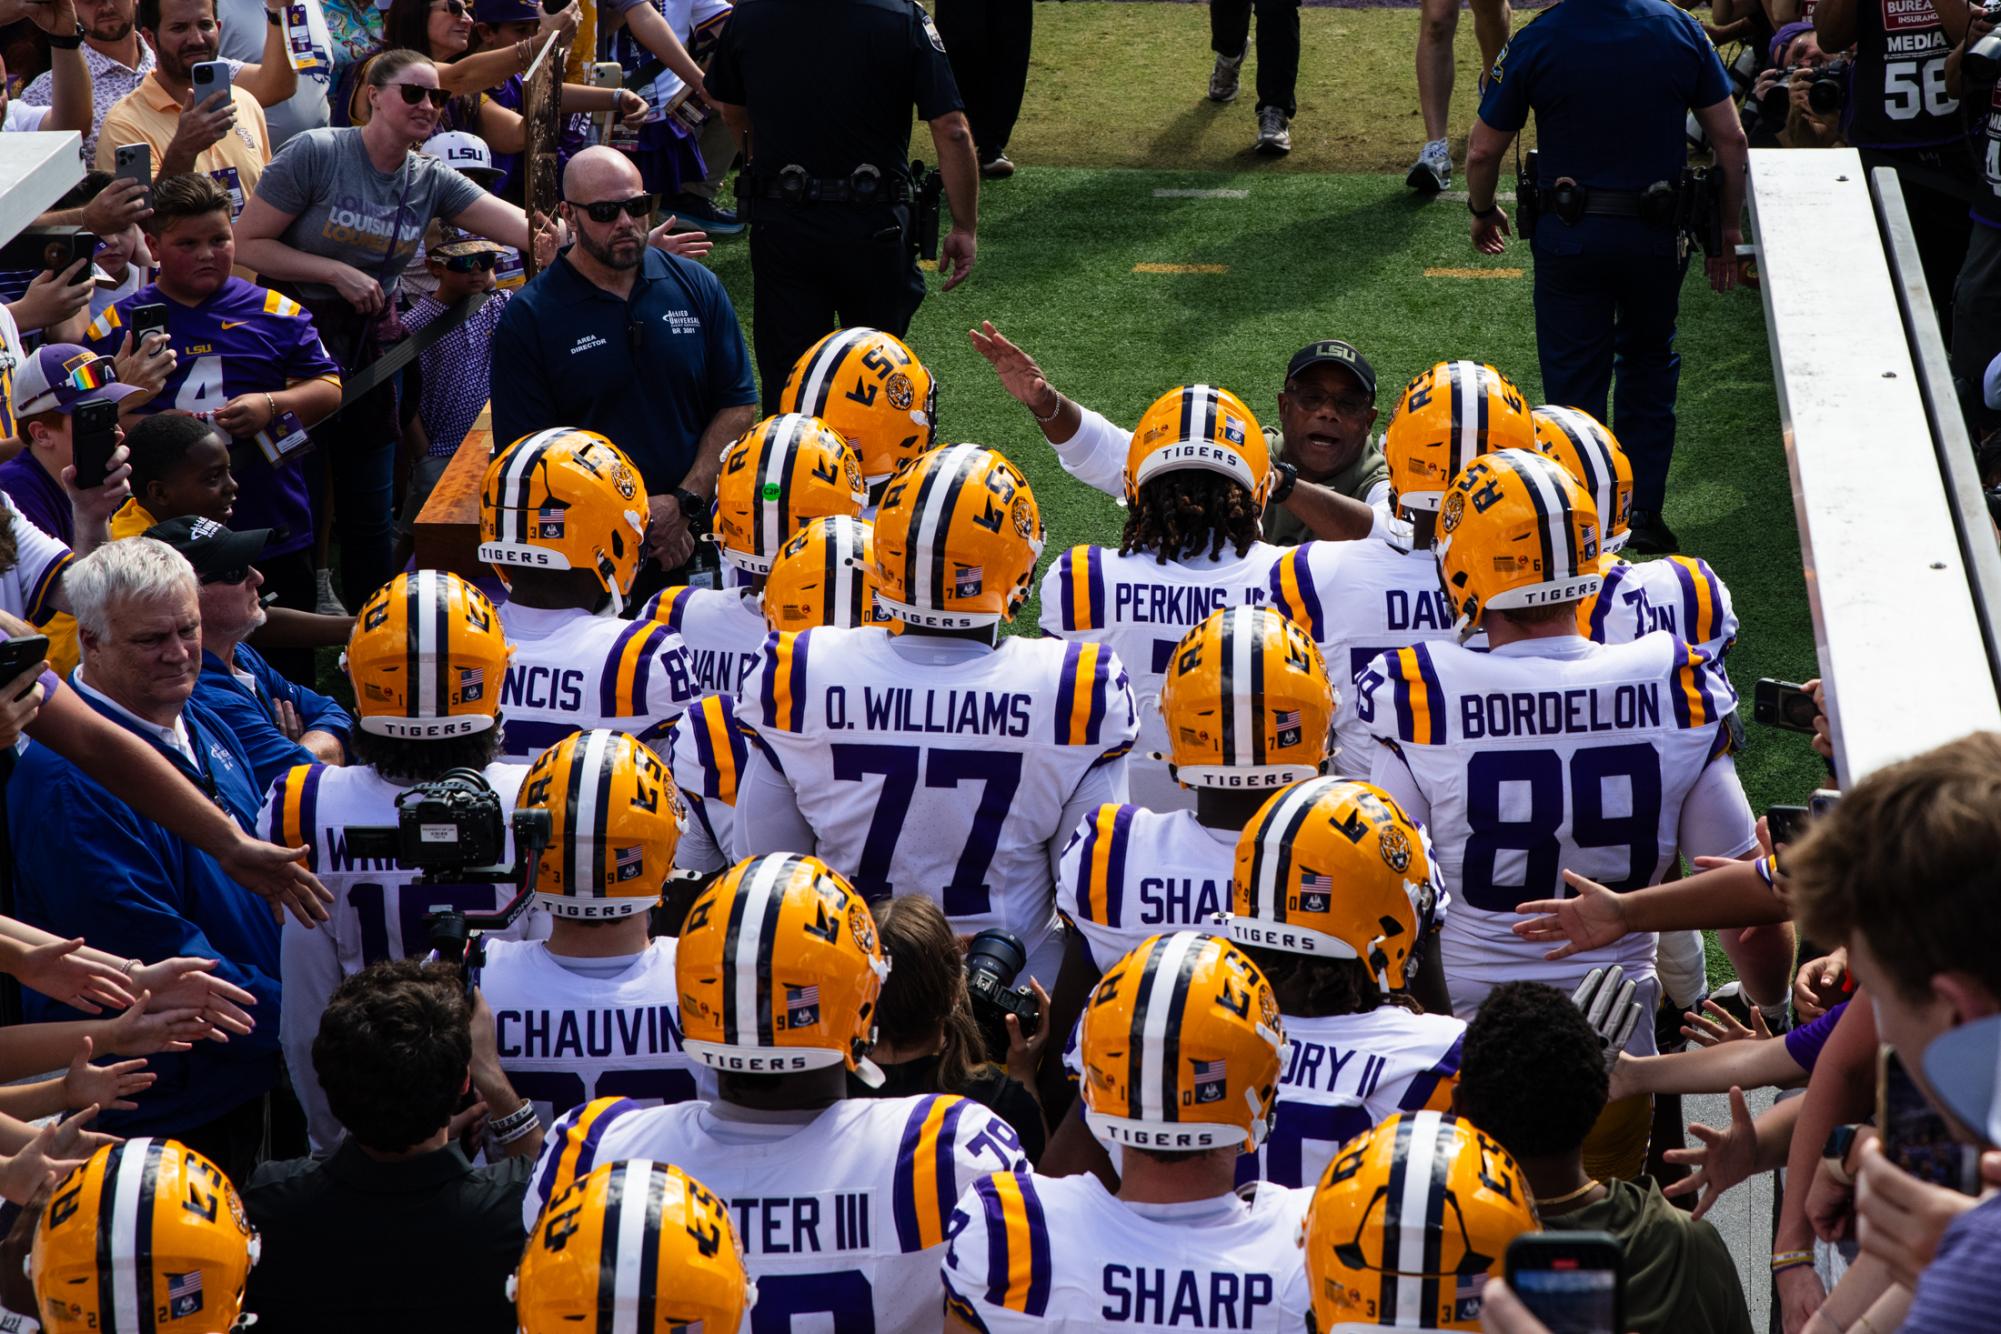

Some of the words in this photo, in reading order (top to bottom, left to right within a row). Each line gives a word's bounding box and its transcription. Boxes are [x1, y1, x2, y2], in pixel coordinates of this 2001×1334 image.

[1887, 31, 1947, 52] MEDIA
[447, 148, 483, 162] LSU
[669, 317, 700, 325] UNIVERSAL
[185, 343, 213, 356] LSU
[570, 338, 607, 355] DIRECTOR
[576, 334, 597, 346] AREA
[1315, 344, 1356, 363] LSU
[175, 355, 233, 445] 4
[1217, 426, 1224, 438] 7
[1162, 445, 1237, 466] TIGERS
[1440, 469, 1447, 481] 7
[763, 486, 781, 495] C2P
[530, 526, 537, 539] 3
[481, 547, 548, 565] TIGERS
[1533, 558, 1541, 572] 6
[946, 588, 954, 599] 7
[1525, 581, 1598, 604] TIGERS
[1115, 582, 1228, 626] PERKINS
[890, 606, 971, 627] TIGERS
[452, 692, 459, 706] 5
[825, 685, 855, 730] O.
[865, 686, 1032, 738] WILLIAMS
[1460, 682, 1661, 740] BORDELON
[385, 721, 472, 737] TIGERS
[1268, 737, 1275, 751] 7
[1203, 771, 1294, 787] TIGERS
[830, 743, 1023, 916] 77
[1462, 742, 1662, 913] 89
[553, 871, 560, 884] 3
[607, 872, 615, 885] 9
[542, 901, 632, 917] TIGERS
[1140, 877, 1233, 925] SHA
[1233, 926, 1315, 950] TIGERS
[712, 1011, 720, 1027] 7
[776, 1015, 786, 1031] 9
[496, 1005, 686, 1058] CHAUVIN
[702, 1052, 806, 1070] TIGERS
[1356, 1053, 1386, 1099] II
[1107, 1125, 1213, 1147] TIGERS
[835, 1192, 870, 1250] III
[1101, 1262, 1274, 1332] SHARP
[87, 1312, 97, 1328] 2
[158, 1307, 168, 1323] 2
[1366, 1299, 1376, 1317] 3
[1442, 1305, 1452, 1324] 3
